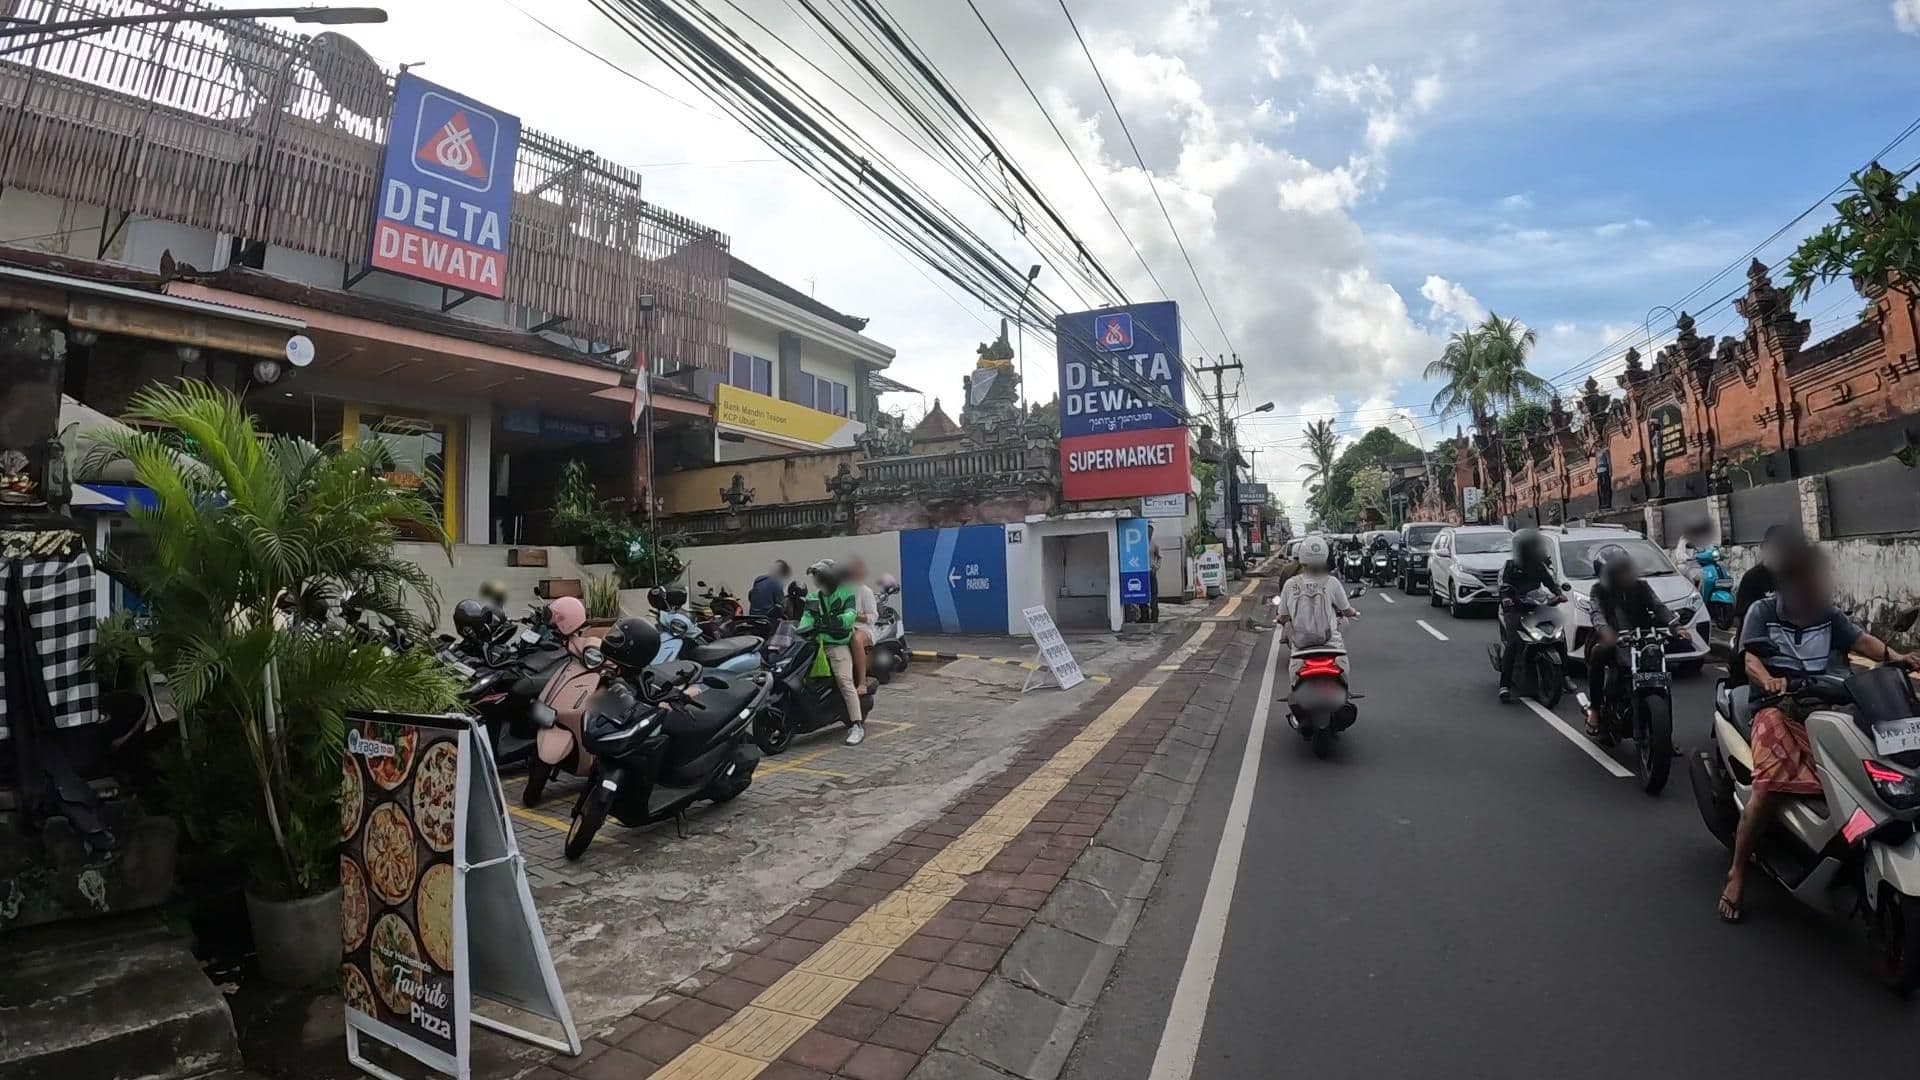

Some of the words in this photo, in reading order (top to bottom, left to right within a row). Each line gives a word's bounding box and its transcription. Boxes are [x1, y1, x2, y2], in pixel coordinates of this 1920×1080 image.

[384, 178, 501, 250] DELTA
[379, 226, 498, 287] DEWATA
[1065, 352, 1172, 390] DELTA
[723, 413, 738, 422] KCP
[1069, 449, 1114, 472] SUPER
[1115, 443, 1175, 468] MARKET
[1008, 530, 1022, 543] 14
[1125, 528, 1142, 552] P
[965, 563, 979, 576] CAR
[966, 577, 990, 590] PARKING
[391, 964, 449, 1009] Favorite
[410, 1001, 451, 1040] Pizza
